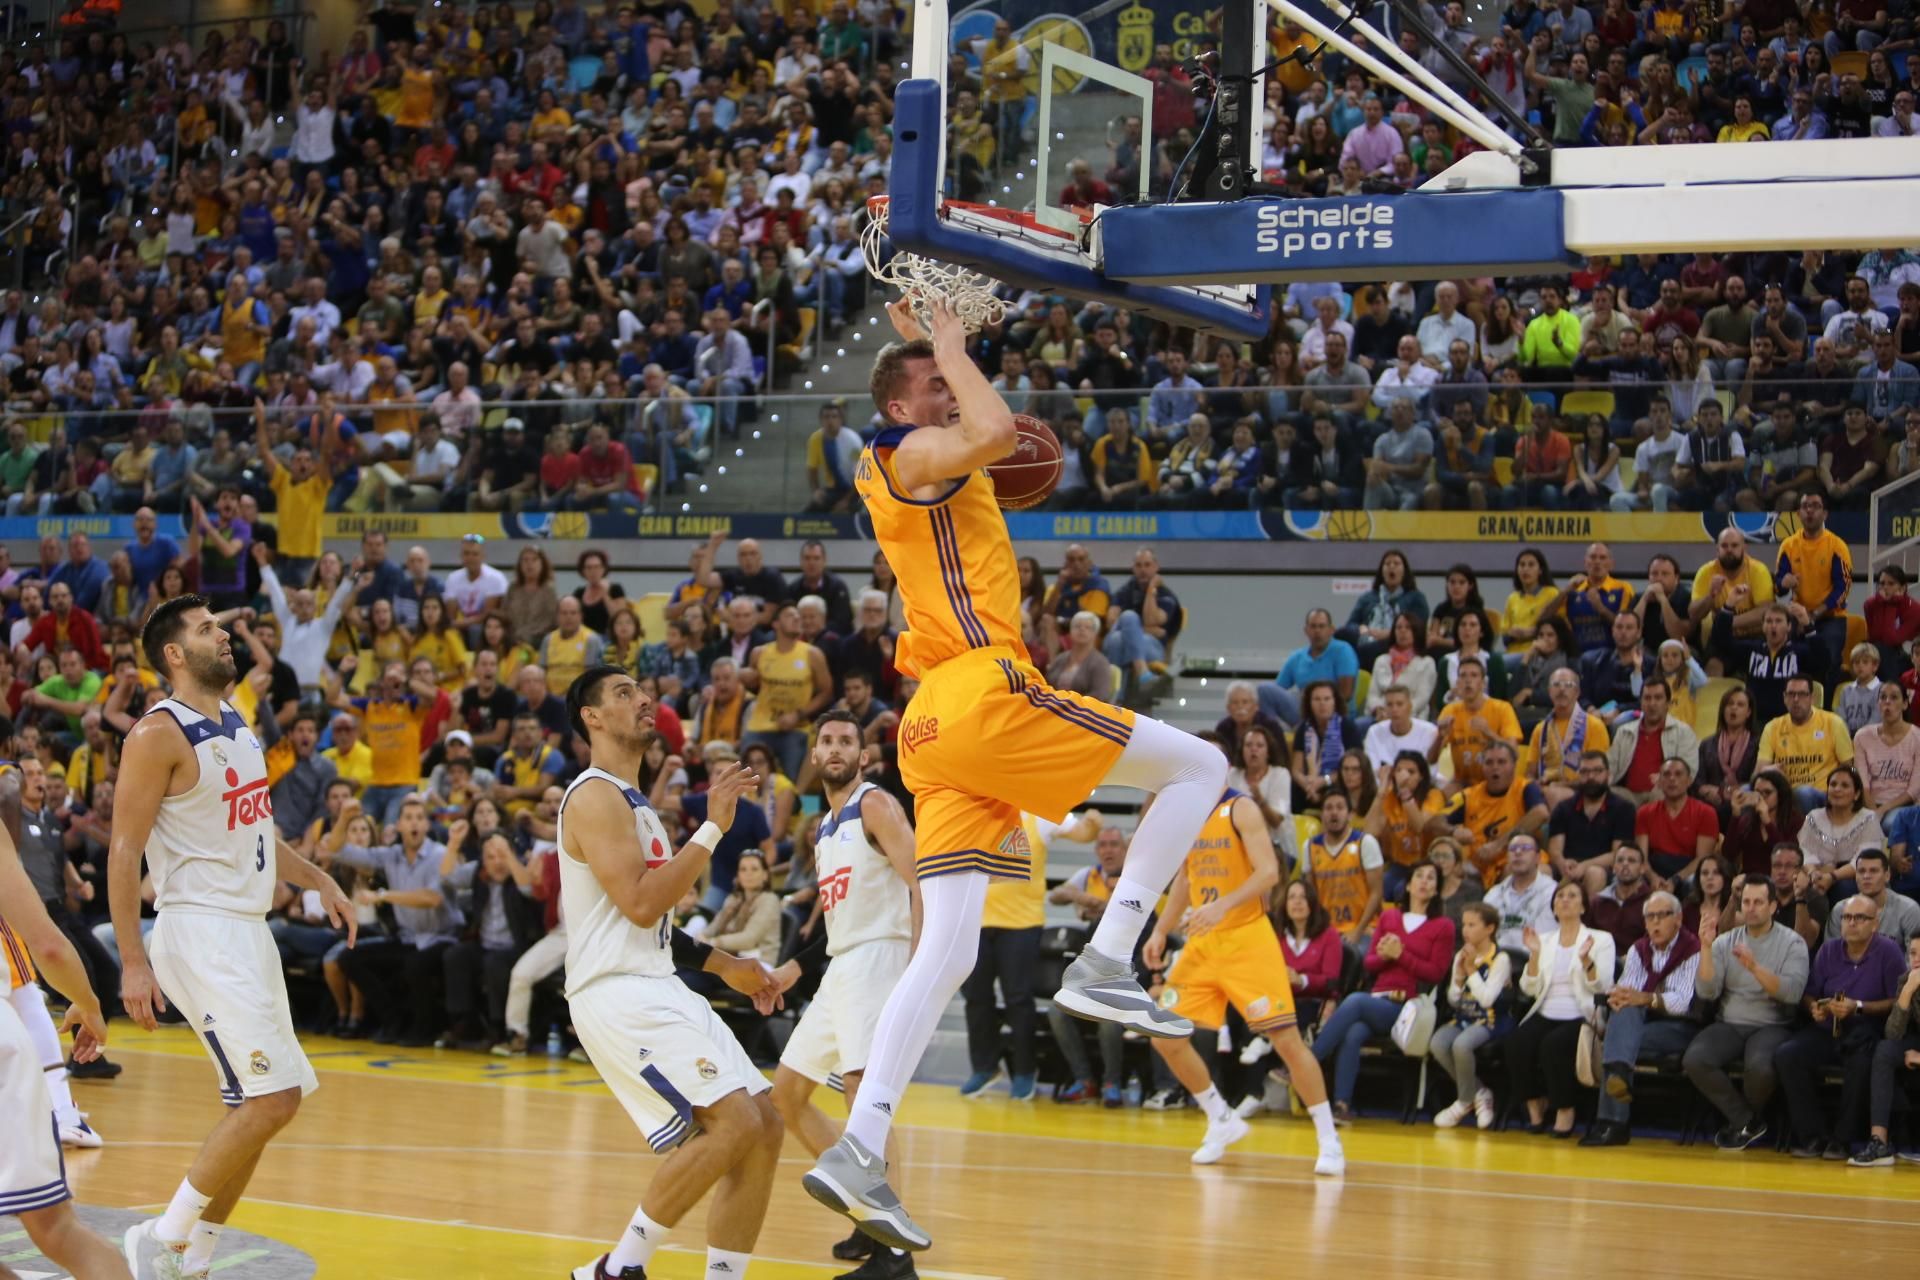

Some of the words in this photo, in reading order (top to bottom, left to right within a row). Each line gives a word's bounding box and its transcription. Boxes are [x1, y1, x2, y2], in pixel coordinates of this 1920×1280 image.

[1257, 202, 1394, 228] Schelde
[1256, 226, 1393, 258] Sports
[337, 518, 365, 534] GRAN
[368, 519, 418, 534] CANARIA
[638, 516, 672, 535] GRAN
[676, 516, 731, 535] CANARIA
[1054, 516, 1091, 535] GRAN
[1097, 516, 1157, 535] CANARIA
[1478, 516, 1518, 536] GRAN
[1526, 517, 1591, 536] CANARIA
[1749, 650, 1799, 678] ITALIA
[902, 715, 939, 758] Kalise
